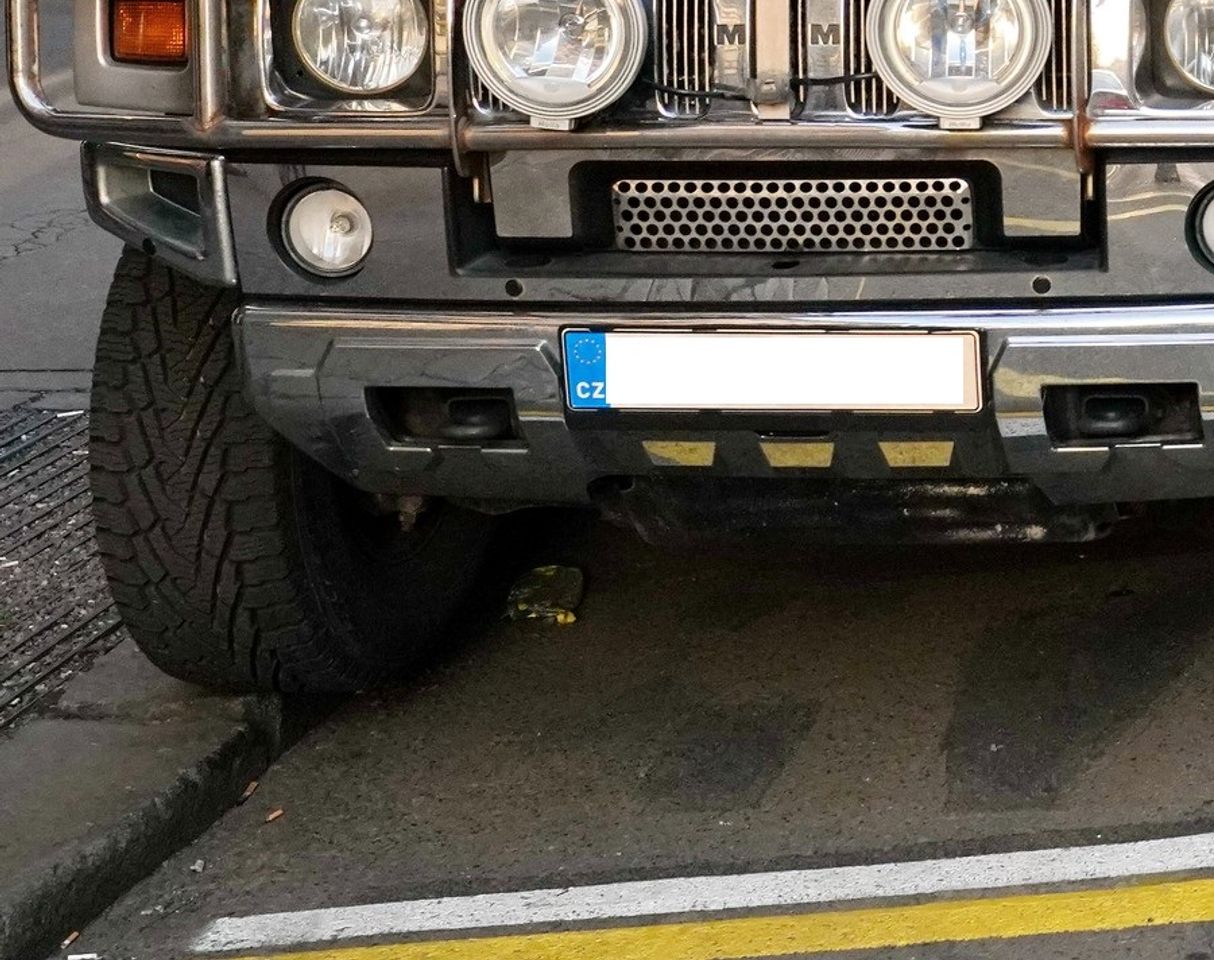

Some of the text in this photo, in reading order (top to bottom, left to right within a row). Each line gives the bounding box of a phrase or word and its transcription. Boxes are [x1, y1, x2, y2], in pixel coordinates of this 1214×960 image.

[716, 24, 841, 45] M M
[576, 381, 606, 399] CZ
